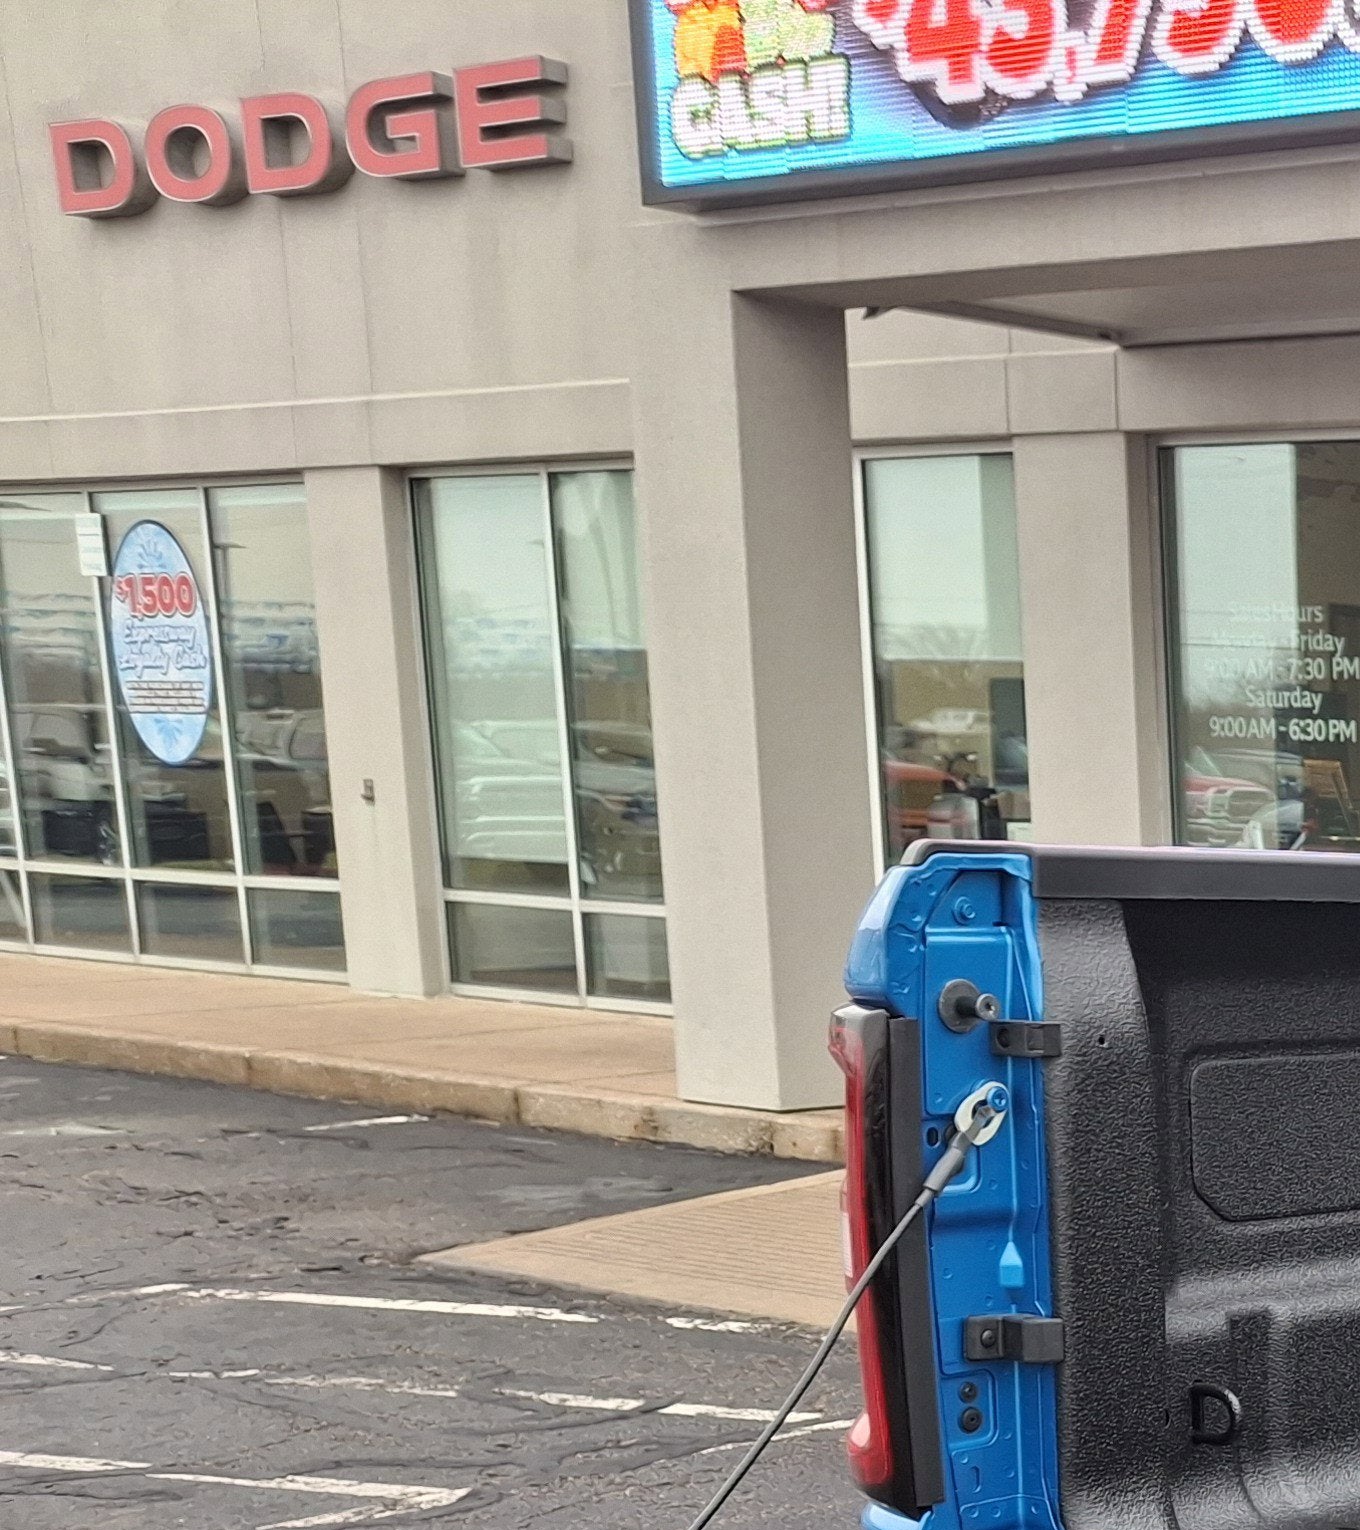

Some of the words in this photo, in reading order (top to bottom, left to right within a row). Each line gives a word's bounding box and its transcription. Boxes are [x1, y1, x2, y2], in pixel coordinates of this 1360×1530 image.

[48, 54, 571, 218] DODGE
[113, 573, 197, 620] $1,500
[1332, 656, 1360, 681] PM
[1245, 685, 1323, 714] Saturday
